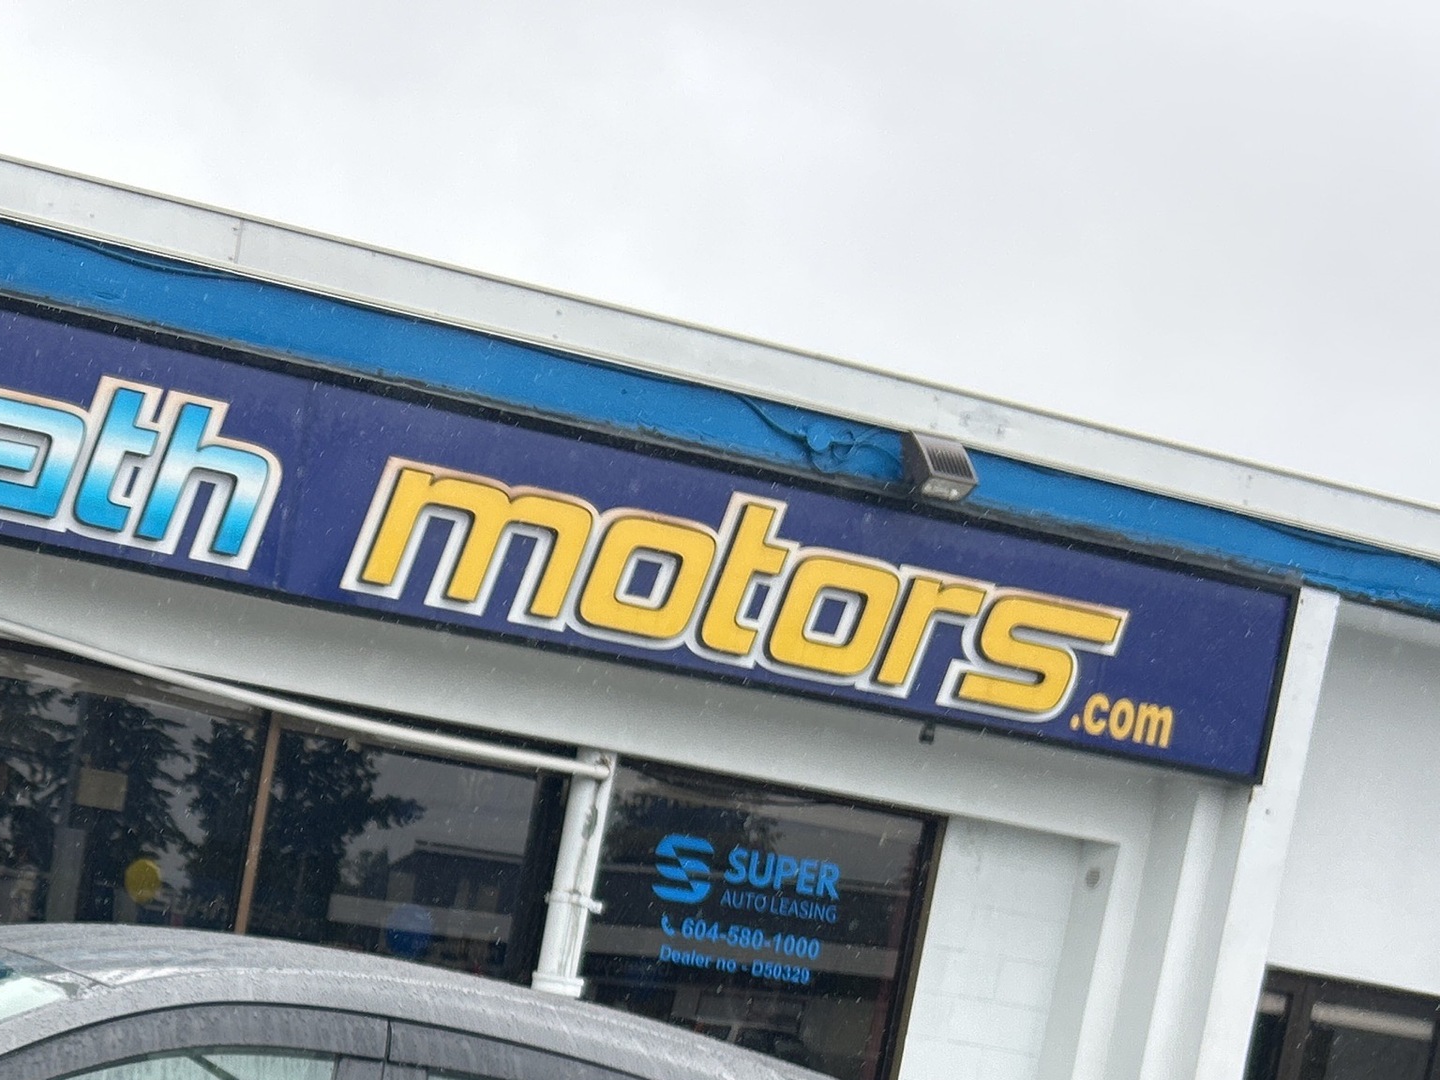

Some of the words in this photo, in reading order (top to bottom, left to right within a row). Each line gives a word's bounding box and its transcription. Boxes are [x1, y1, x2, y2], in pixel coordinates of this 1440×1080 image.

[340, 456, 1129, 724] motors
[1070, 693, 1173, 748] .com
[723, 846, 840, 900] SUPER
[720, 888, 766, 913] AUTO
[770, 896, 837, 924] LEASING
[660, 944, 710, 968] Dealer
[716, 957, 736, 973] no
[681, 917, 820, 960] 604-580-1000
